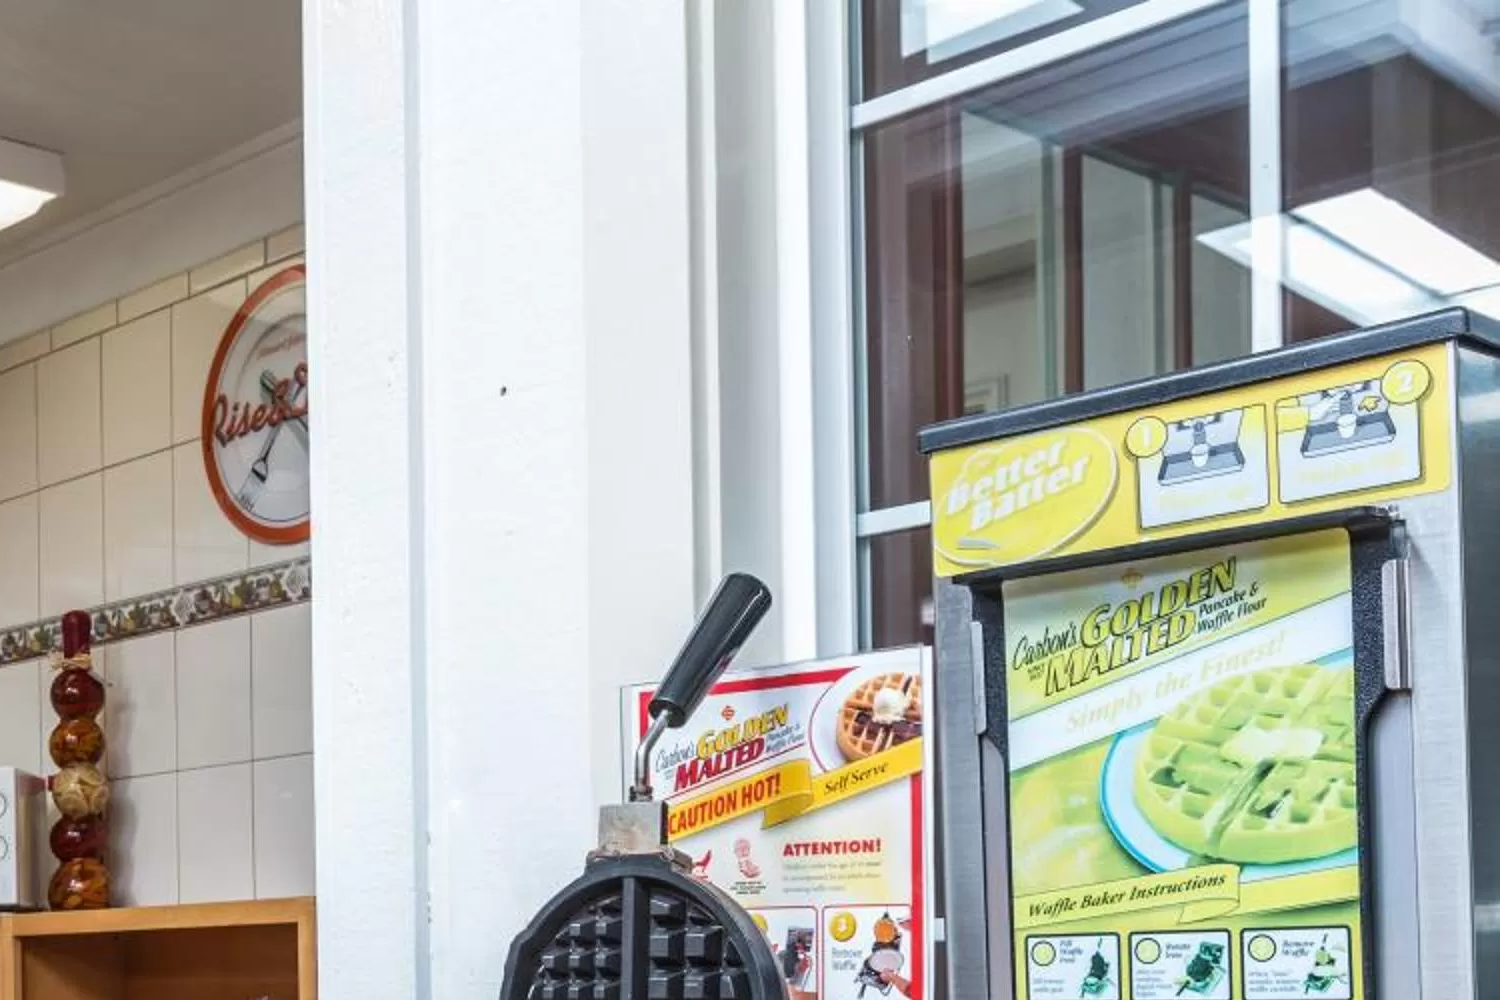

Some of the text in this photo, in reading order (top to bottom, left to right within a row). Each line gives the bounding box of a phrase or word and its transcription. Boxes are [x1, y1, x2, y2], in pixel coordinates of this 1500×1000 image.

[1396, 370, 1414, 392] 2
[1079, 556, 1237, 649] GOLDEN
[1198, 597, 1268, 634] Waffle Flour
[1199, 581, 1260, 616] Pancake &
[1044, 610, 1197, 697] MALTED
[1067, 683, 1147, 733] Simply
[1155, 671, 1193, 698] the
[696, 703, 789, 760] GOLDEN
[674, 737, 765, 792] MALTED
[823, 762, 890, 796] Self Serve
[668, 772, 781, 835] CAUTION HOT!
[784, 839, 881, 857] ATTENTION!
[1028, 873, 1227, 919] Waffle Baker Instructions
